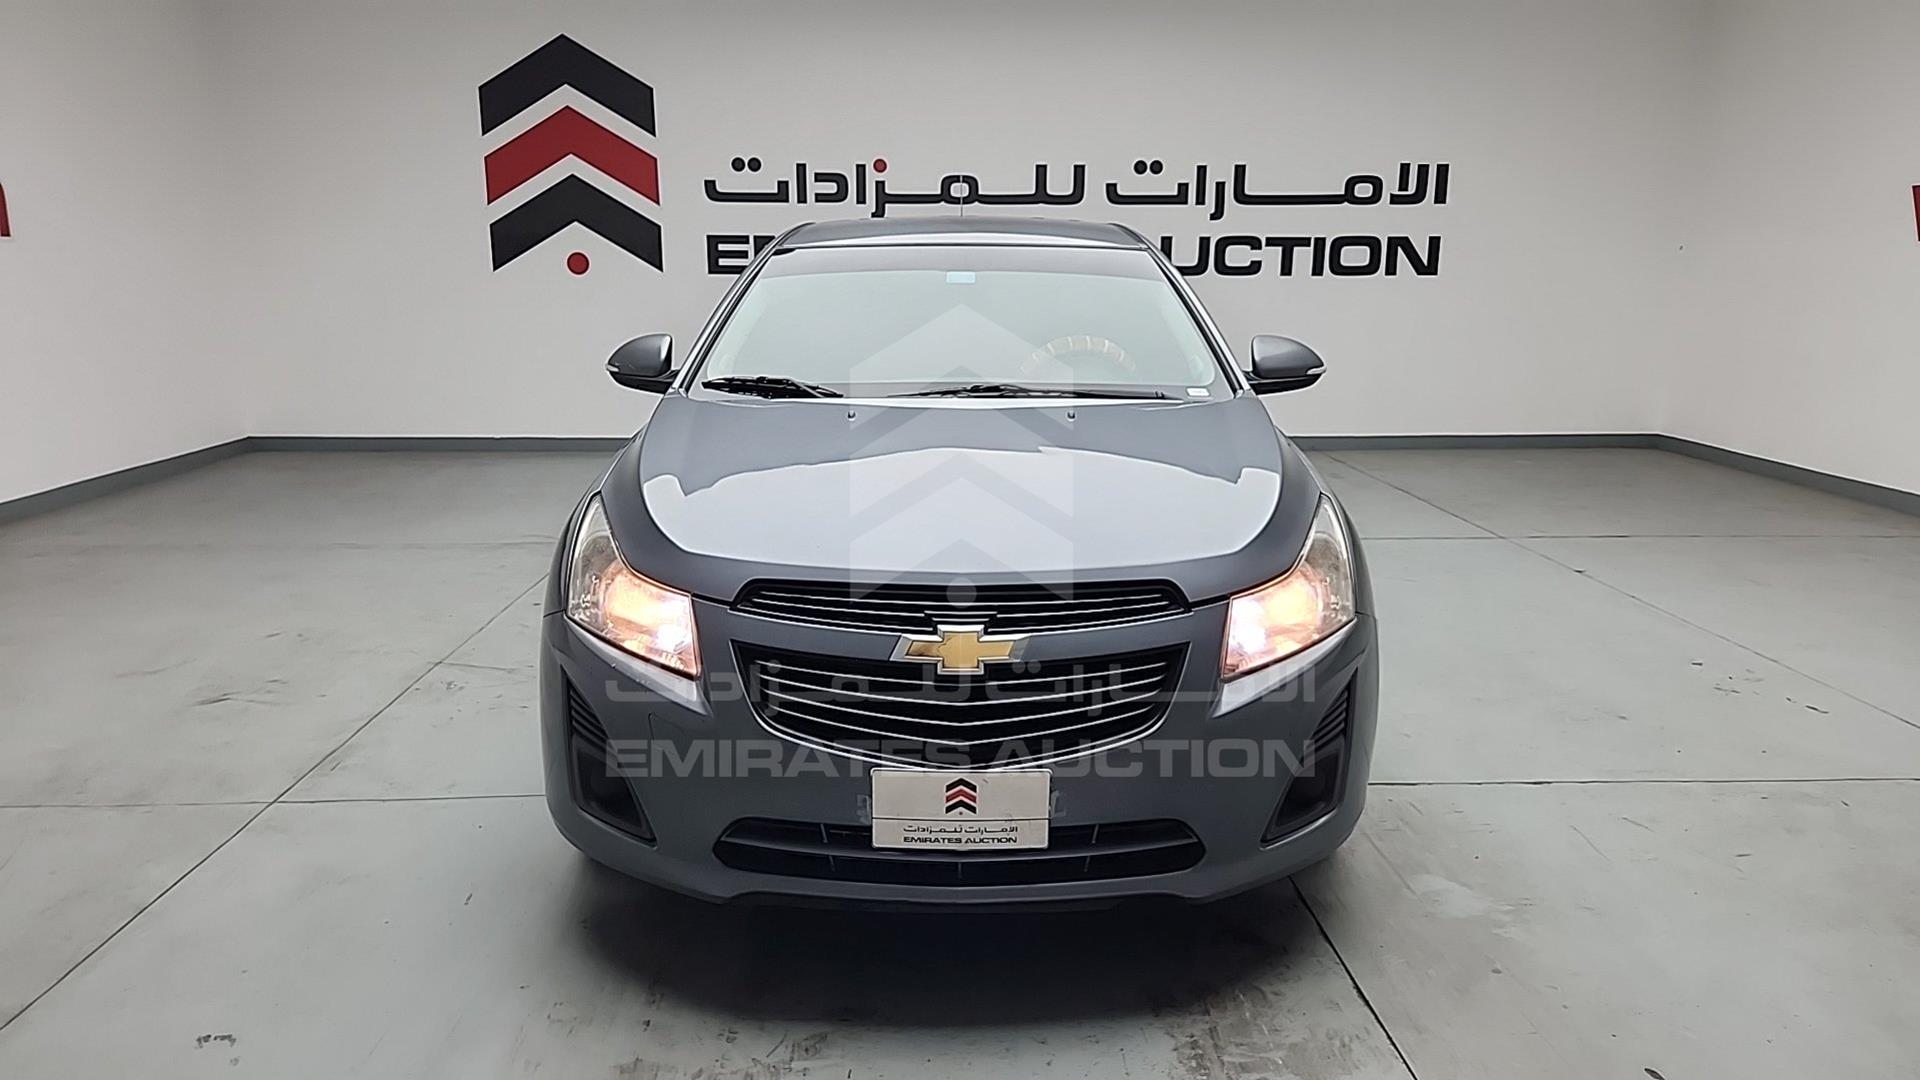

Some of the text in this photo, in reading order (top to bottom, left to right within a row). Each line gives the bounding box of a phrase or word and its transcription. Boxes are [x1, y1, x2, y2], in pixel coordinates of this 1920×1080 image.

[704, 156, 1085, 218] للمزادات
[1161, 235, 1442, 277] UCTION
[903, 836, 1017, 844] EMIRATES AUCTION
